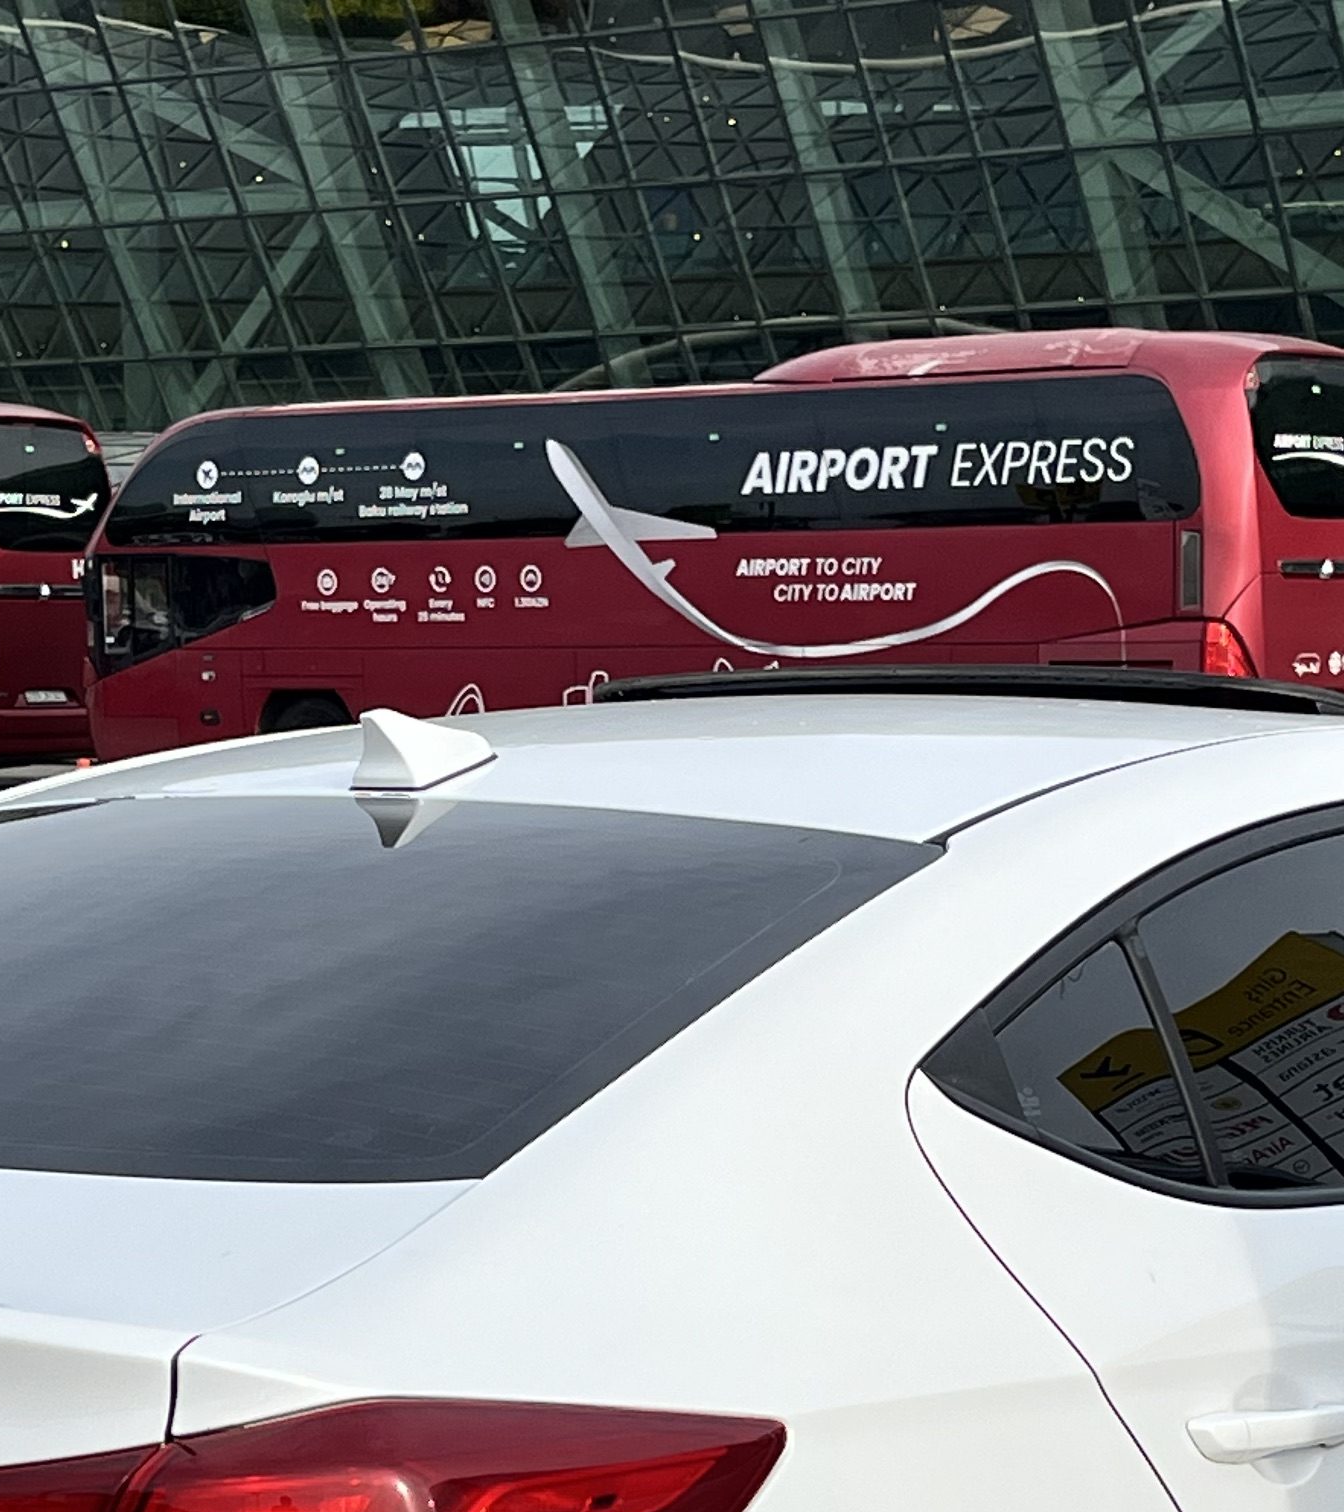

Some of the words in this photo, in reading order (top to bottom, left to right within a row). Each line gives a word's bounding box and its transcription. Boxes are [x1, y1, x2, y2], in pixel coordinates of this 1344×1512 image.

[1273, 433, 1311, 449] AIRPORT
[1313, 435, 1344, 451] EXPRESS
[741, 445, 939, 496] AIRPORT
[951, 437, 1135, 487] EXPRESS
[26, 494, 61, 506] EXPRESS
[189, 508, 226, 525] Airport
[736, 558, 811, 578] AIRPORT
[815, 558, 840, 576] TO
[842, 556, 883, 575] CITY
[773, 583, 814, 603] CITY
[815, 584, 839, 601] TO
[839, 582, 917, 602] AIRPORT
